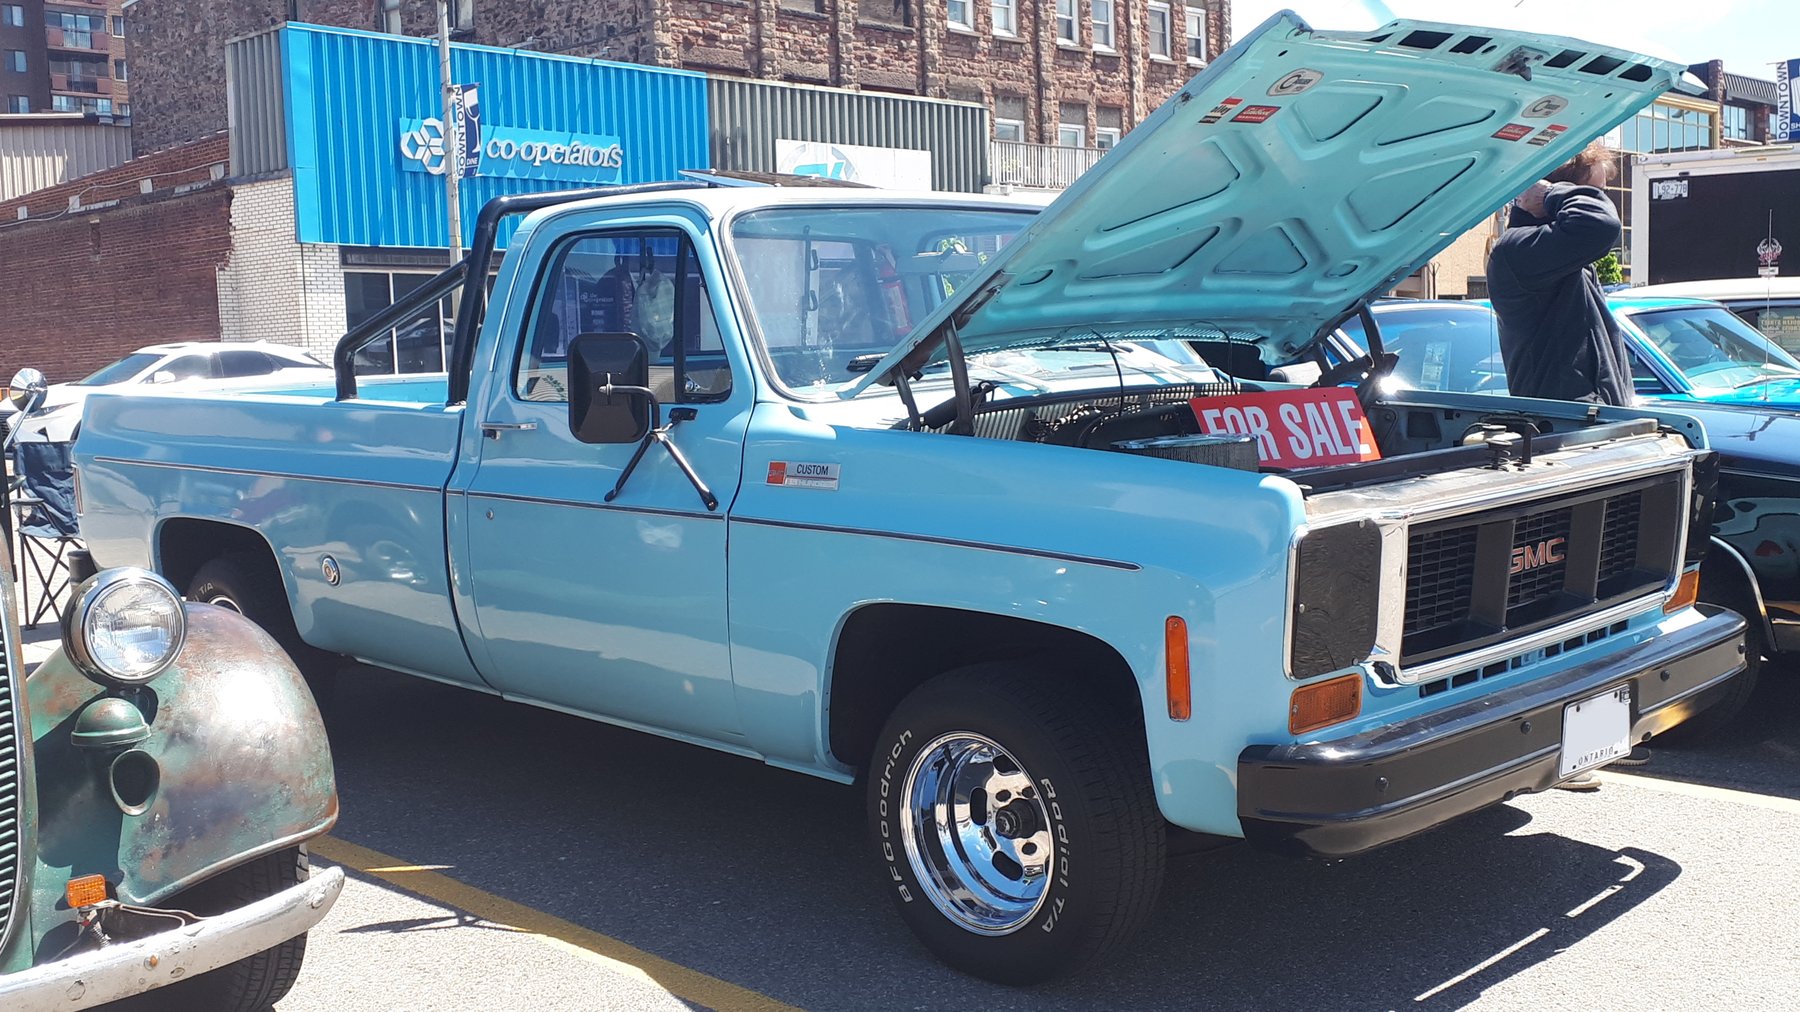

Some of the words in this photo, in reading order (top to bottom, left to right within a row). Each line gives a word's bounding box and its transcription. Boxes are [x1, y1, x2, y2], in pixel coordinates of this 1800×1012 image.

[1777, 61, 1789, 139] DOWNTOWN
[455, 87, 466, 177] DOWNTOWN
[466, 157, 479, 166] DINE
[1279, 399, 1372, 460] SALE
[796, 464, 829, 476] CUSTOM
[1508, 537, 1565, 574] GMC
[199, 582, 214, 595] T/A
[1578, 746, 1614, 766] ONTARIO
[879, 729, 914, 903] BFGoodrich
[1040, 778, 1070, 888] Radial
[1042, 898, 1065, 933] T/A
